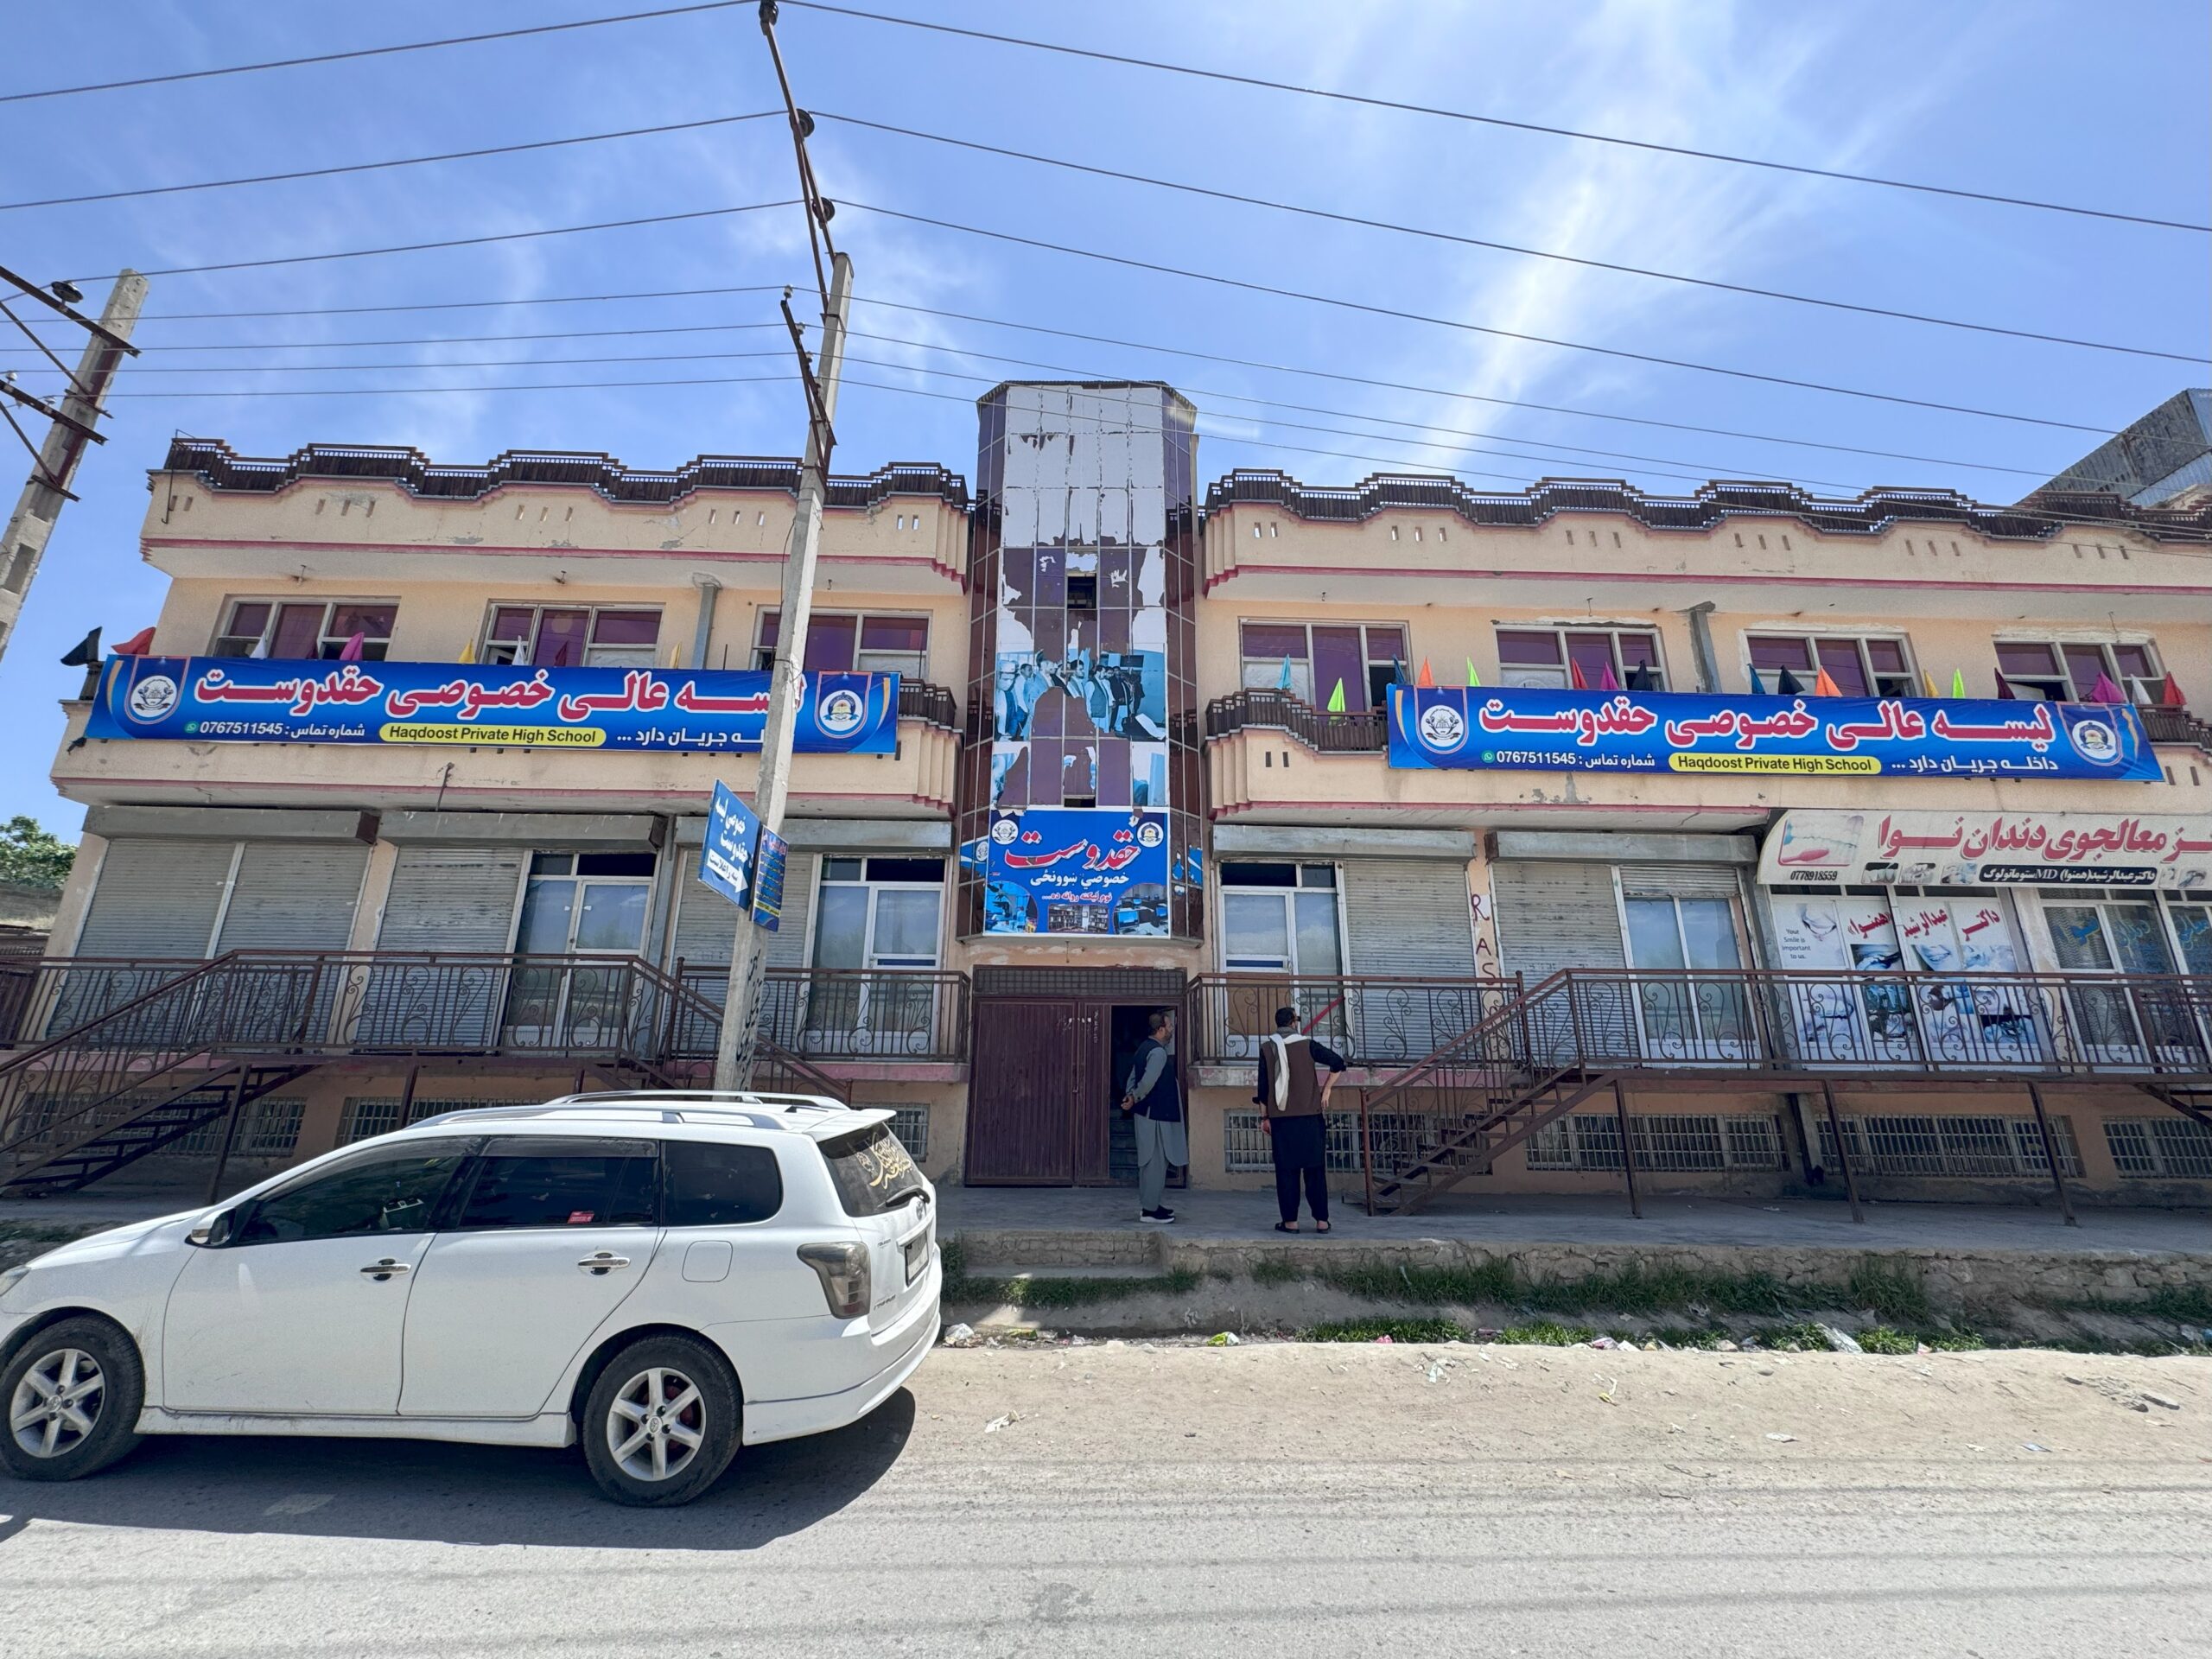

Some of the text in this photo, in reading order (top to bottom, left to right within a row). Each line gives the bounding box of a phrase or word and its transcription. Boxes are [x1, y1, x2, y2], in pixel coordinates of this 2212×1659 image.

[194, 665, 384, 716] حقدوست
[385, 669, 555, 720] خصوصی
[557, 670, 670, 722] عالی
[200, 721, 283, 734] 0767511545
[328, 723, 365, 738] شماره
[1479, 696, 2056, 753] لیسه عالی خصوصی حقدوست
[390, 726, 596, 743] Haqdoost Private High School
[635, 727, 665, 746] دارد
[668, 728, 728, 747] جریان
[1497, 751, 1576, 765] 0767511545
[1620, 753, 1655, 768] شماره
[1678, 755, 1872, 772] Haqdoost Private High School
[1909, 755, 1938, 772] دارد
[1941, 755, 1998, 773] جریان
[2000, 756, 2058, 770] داخله
[1004, 830, 1141, 871] حقدوست
